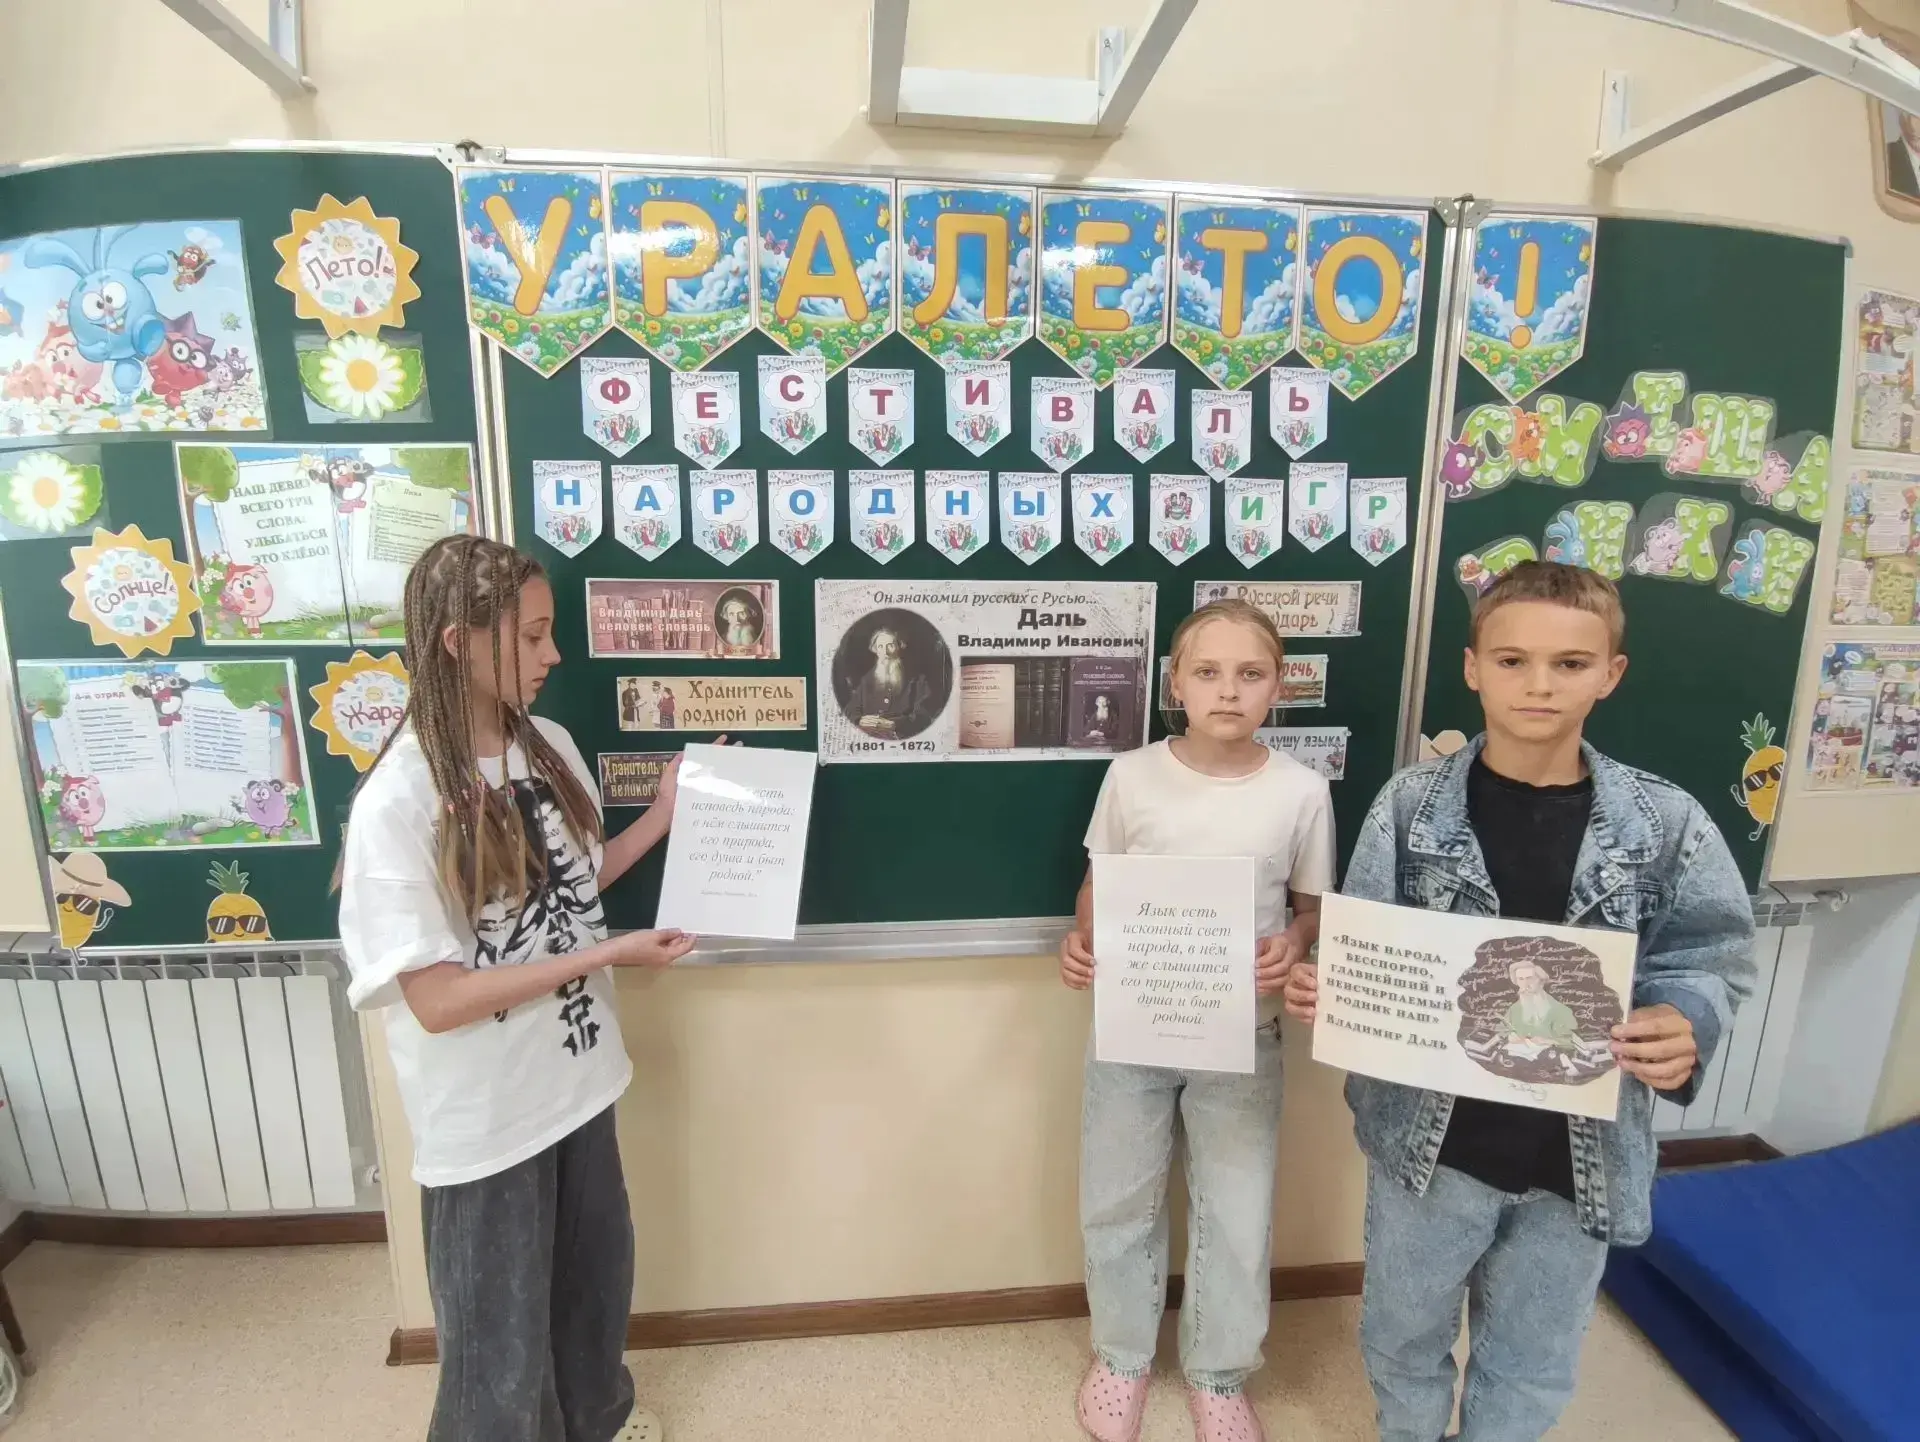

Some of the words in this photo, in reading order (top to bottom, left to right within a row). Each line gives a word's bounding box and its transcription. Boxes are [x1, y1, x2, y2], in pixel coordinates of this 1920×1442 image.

[305, 246, 383, 290] Лето!
[600, 373, 1310, 434] ФЕСТИВАЛЬ
[232, 483, 266, 498] НАШ
[240, 499, 284, 514] ВСЕГО
[554, 479, 1115, 518] НАРОДНЫХ
[1240, 481, 1388, 521] ИГР
[244, 528, 328, 549] УЛЫБАТЬСЯ
[251, 552, 279, 565] ЭТО
[94, 572, 169, 613] Солнце!
[873, 590, 893, 604] Он
[896, 592, 968, 604] знакомил
[972, 593, 1027, 607] русских
[1030, 595, 1038, 604] с
[1041, 592, 1098, 607] Русью...
[1303, 592, 1339, 609] речи
[598, 606, 666, 618] Владимир
[669, 606, 703, 618] Даль
[1017, 608, 1087, 630] Даль
[957, 634, 1051, 649] Владимир
[1056, 634, 1145, 648] Иванович
[687, 680, 794, 704] Хранитель
[682, 705, 747, 726] родной
[754, 709, 798, 726] речи
[849, 741, 885, 753] (1801
[900, 741, 936, 753] 1872)
[601, 756, 660, 783] Хранитель
[611, 783, 659, 797] великого
[1137, 902, 1178, 917] Язык
[1181, 908, 1217, 918] есть
[1123, 923, 1194, 936] исконный
[1197, 927, 1232, 937] свет
[1127, 940, 1183, 957] народа,
[1187, 947, 1196, 956] в
[1199, 943, 1228, 956] нём
[1126, 961, 1149, 970] же
[1152, 962, 1230, 974] слышится
[1345, 952, 1434, 979] БЕССПОРНО,
[1120, 977, 1141, 987] его
[1145, 975, 1208, 992] природа,
[1212, 983, 1233, 992] его
[1330, 963, 1430, 992] ГЛАВНЕЙШИЙ
[1434, 985, 1446, 995] И
[1136, 993, 1174, 1008] душа
[1177, 998, 1186, 1007] и
[1190, 995, 1222, 1009] быт
[1325, 976, 1453, 1012] НЕИСЧЕРПАЕМЫЙ
[1335, 994, 1392, 1016] РОДНИК
[1152, 1010, 1206, 1025] родной.
